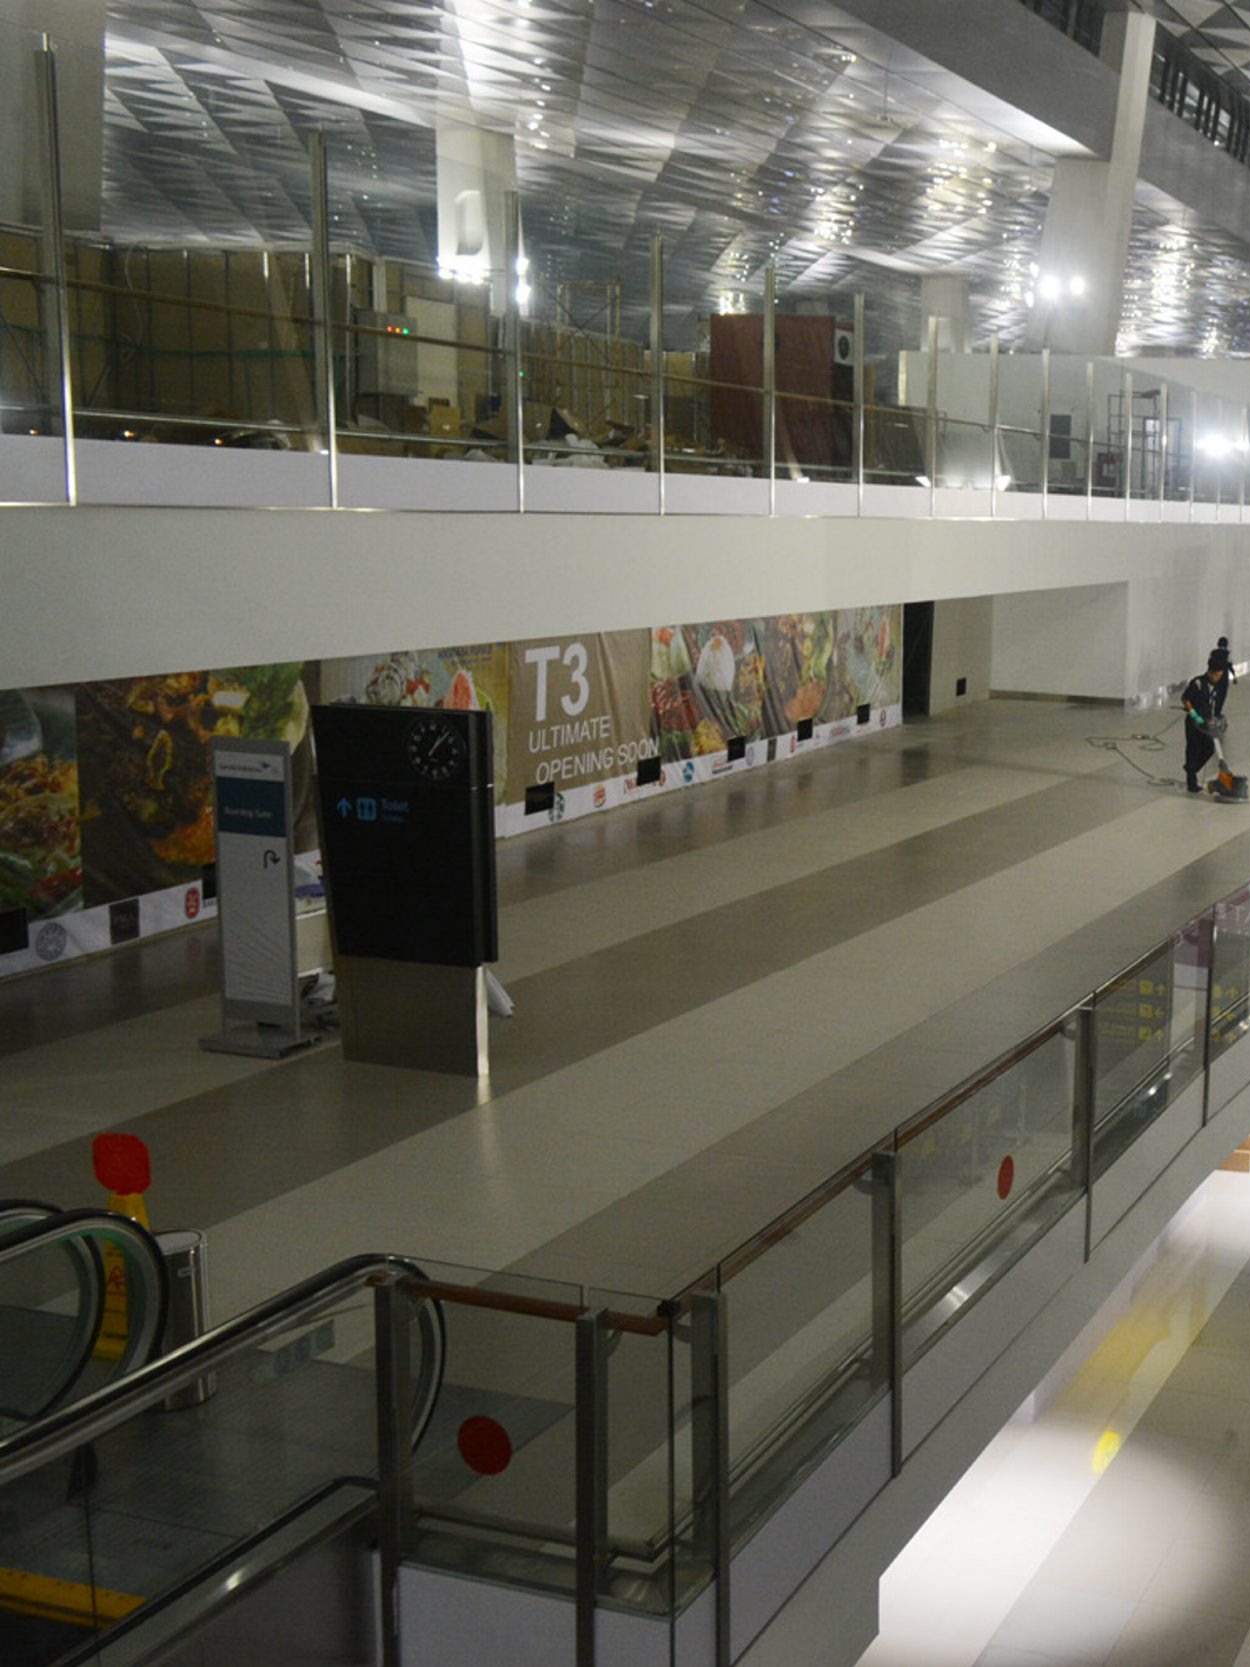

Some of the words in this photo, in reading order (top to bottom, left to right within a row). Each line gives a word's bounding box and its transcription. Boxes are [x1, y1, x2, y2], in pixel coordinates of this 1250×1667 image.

[525, 643, 590, 721] T3
[529, 715, 611, 753] ULTIMATE
[536, 747, 614, 784] OPENING
[617, 735, 660, 766] SOON
